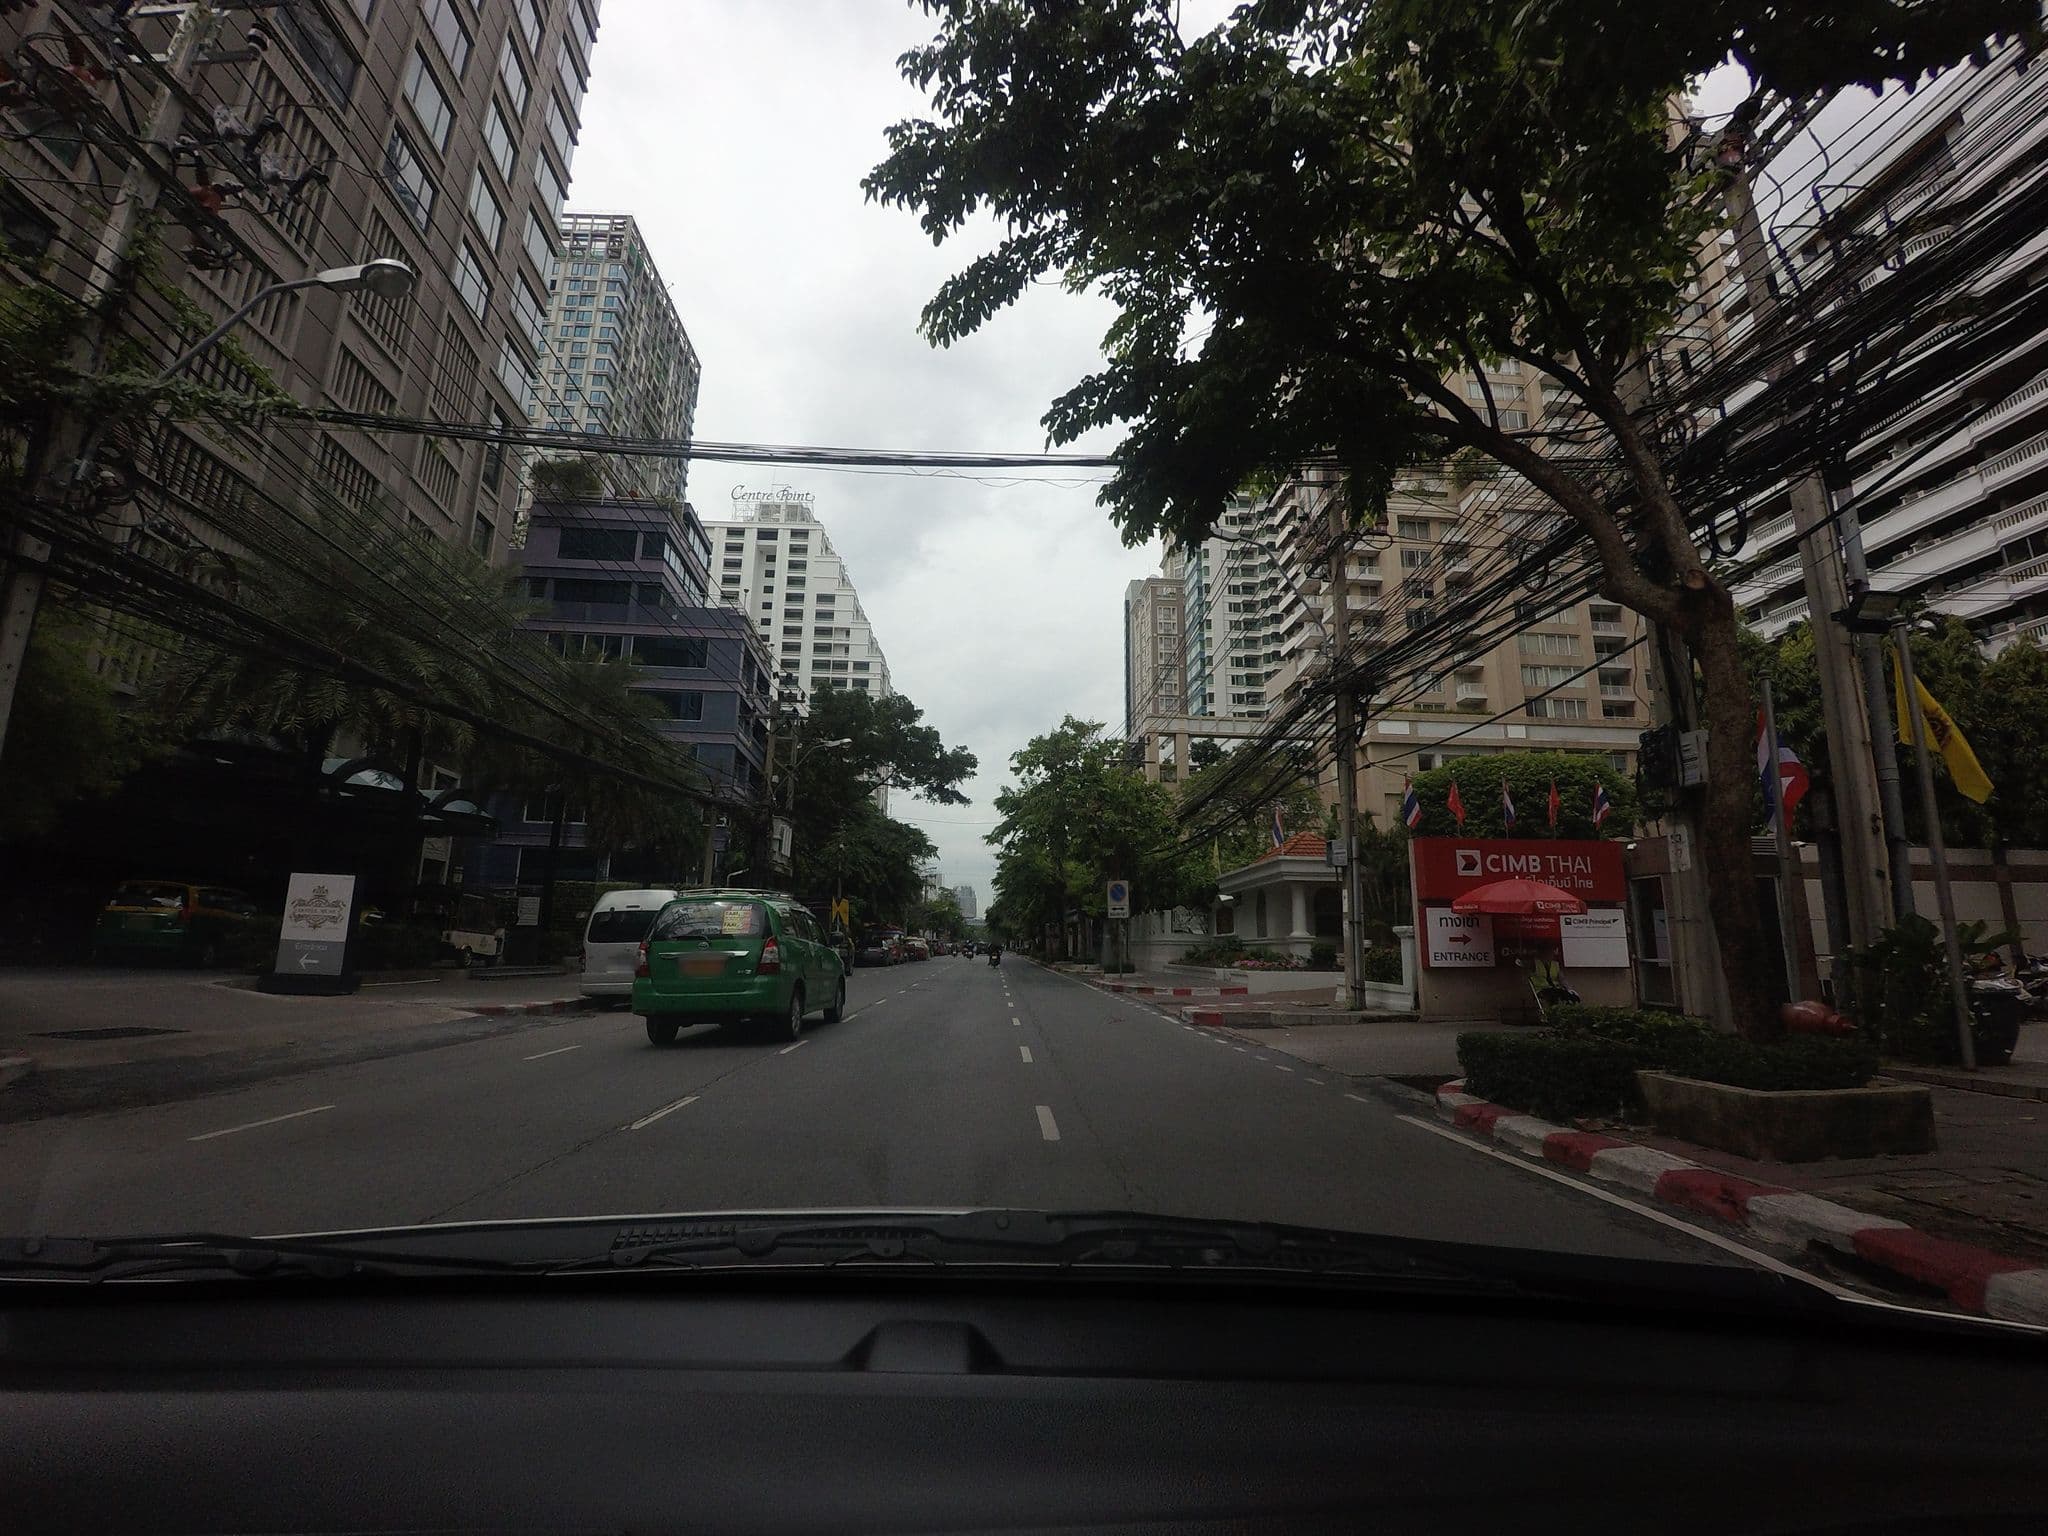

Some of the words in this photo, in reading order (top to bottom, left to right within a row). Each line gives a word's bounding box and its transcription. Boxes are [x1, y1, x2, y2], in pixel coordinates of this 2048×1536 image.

[731, 484, 774, 502] Centre
[776, 485, 815, 502] Point
[1486, 854, 1541, 873] CIMB
[1545, 855, 1592, 874] THAI
[1433, 952, 1490, 962] ENTRANCE
